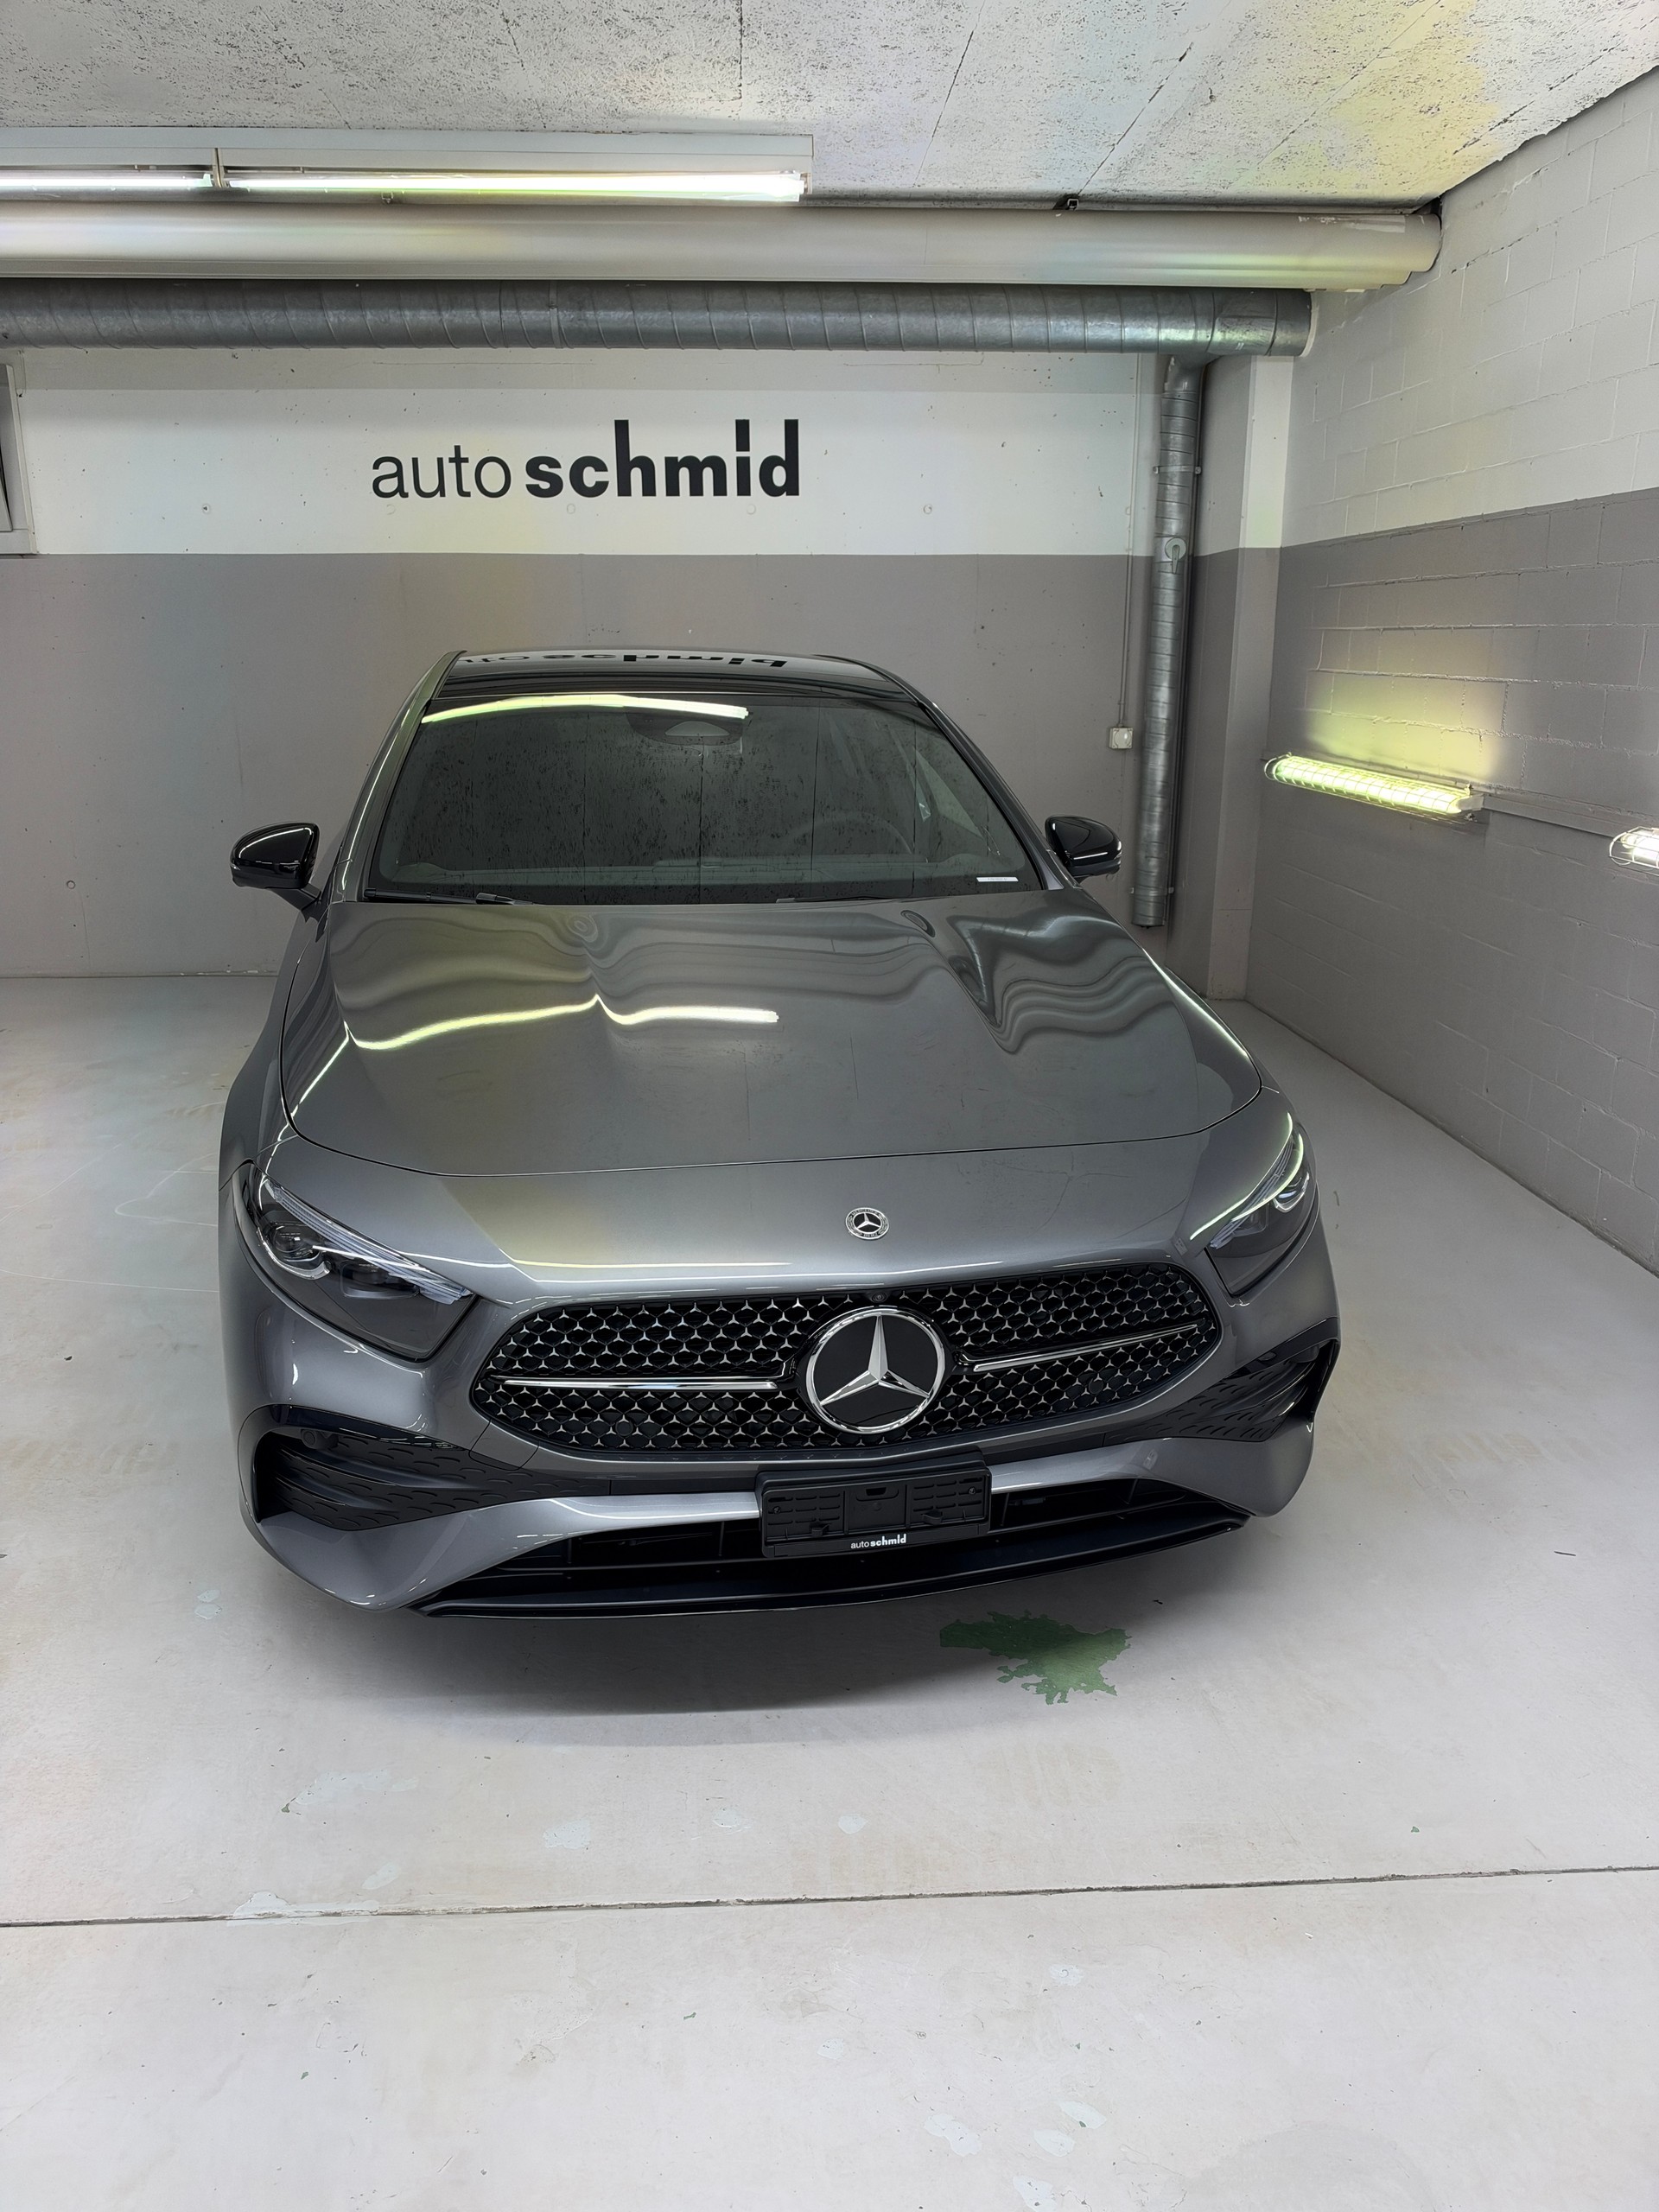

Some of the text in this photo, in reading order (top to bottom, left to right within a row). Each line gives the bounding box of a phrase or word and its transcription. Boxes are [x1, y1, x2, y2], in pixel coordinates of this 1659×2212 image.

[372, 419, 800, 499] auto schmid
[850, 1534, 907, 1549] auto schmid
